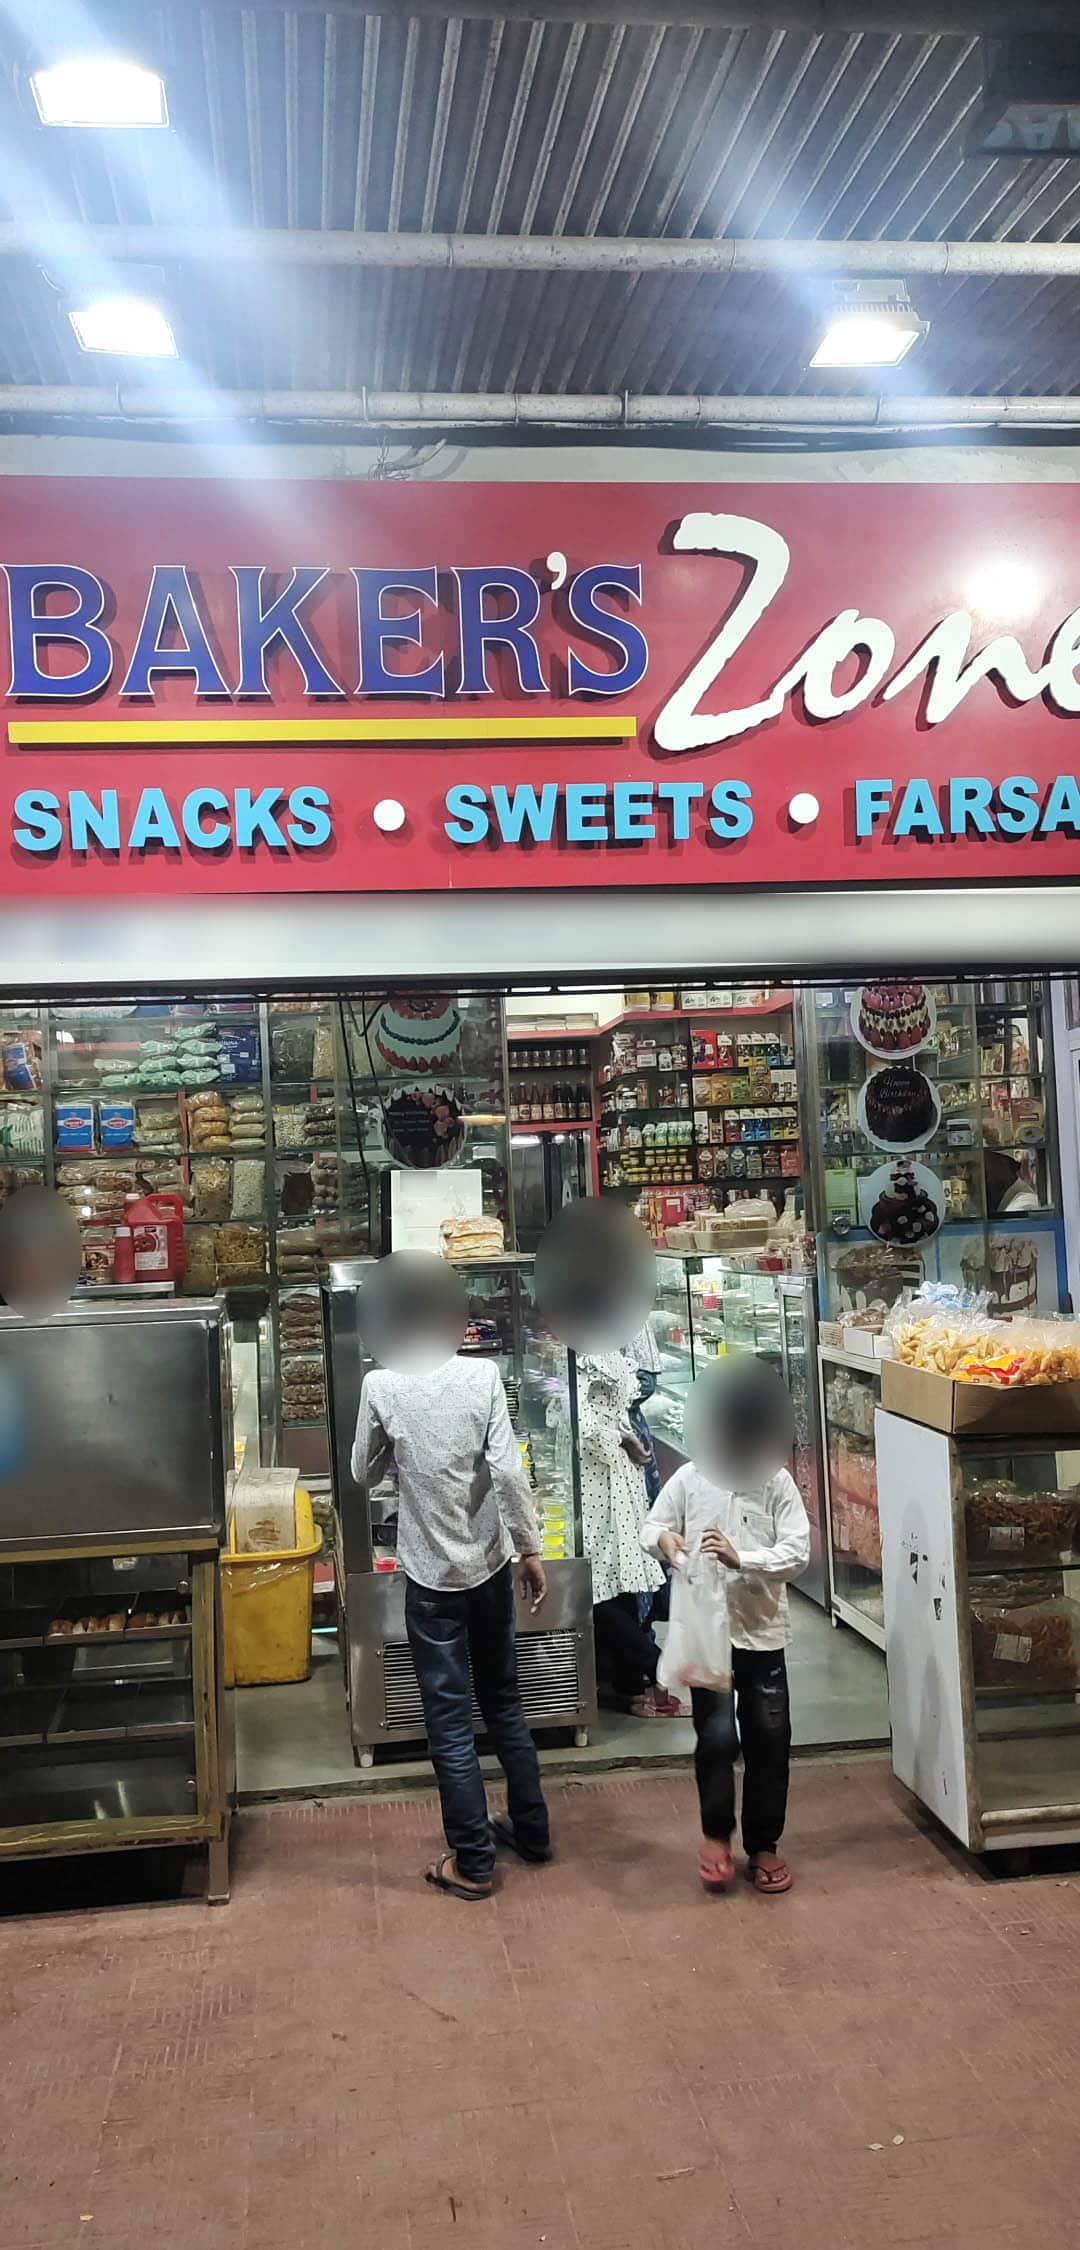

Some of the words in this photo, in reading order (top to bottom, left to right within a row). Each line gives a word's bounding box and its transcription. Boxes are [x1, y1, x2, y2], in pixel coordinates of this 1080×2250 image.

[0, 551, 649, 697] BAKER'S
[14, 786, 332, 851] SNACKS
[444, 781, 754, 844] SWEETS
[856, 776, 1080, 837] FARSA
